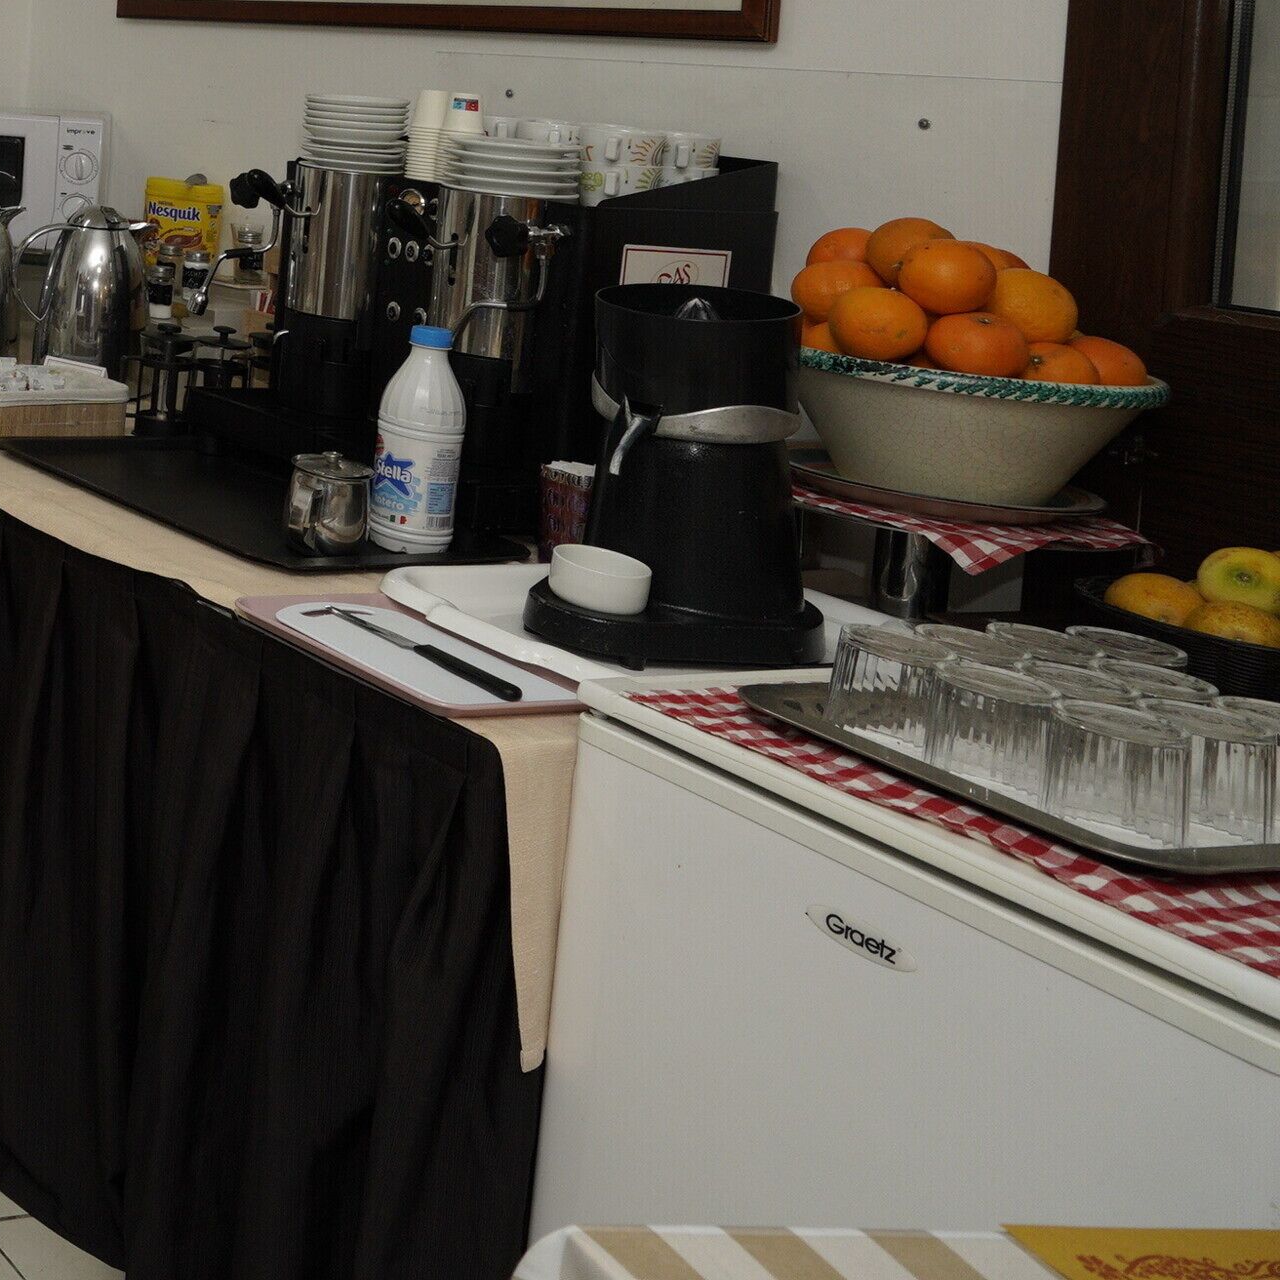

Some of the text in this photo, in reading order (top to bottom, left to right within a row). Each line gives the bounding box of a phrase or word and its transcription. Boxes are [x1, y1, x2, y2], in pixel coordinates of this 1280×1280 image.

[148, 201, 200, 222] Nesquik
[376, 459, 412, 483] Stella
[825, 913, 896, 965] Graetz
